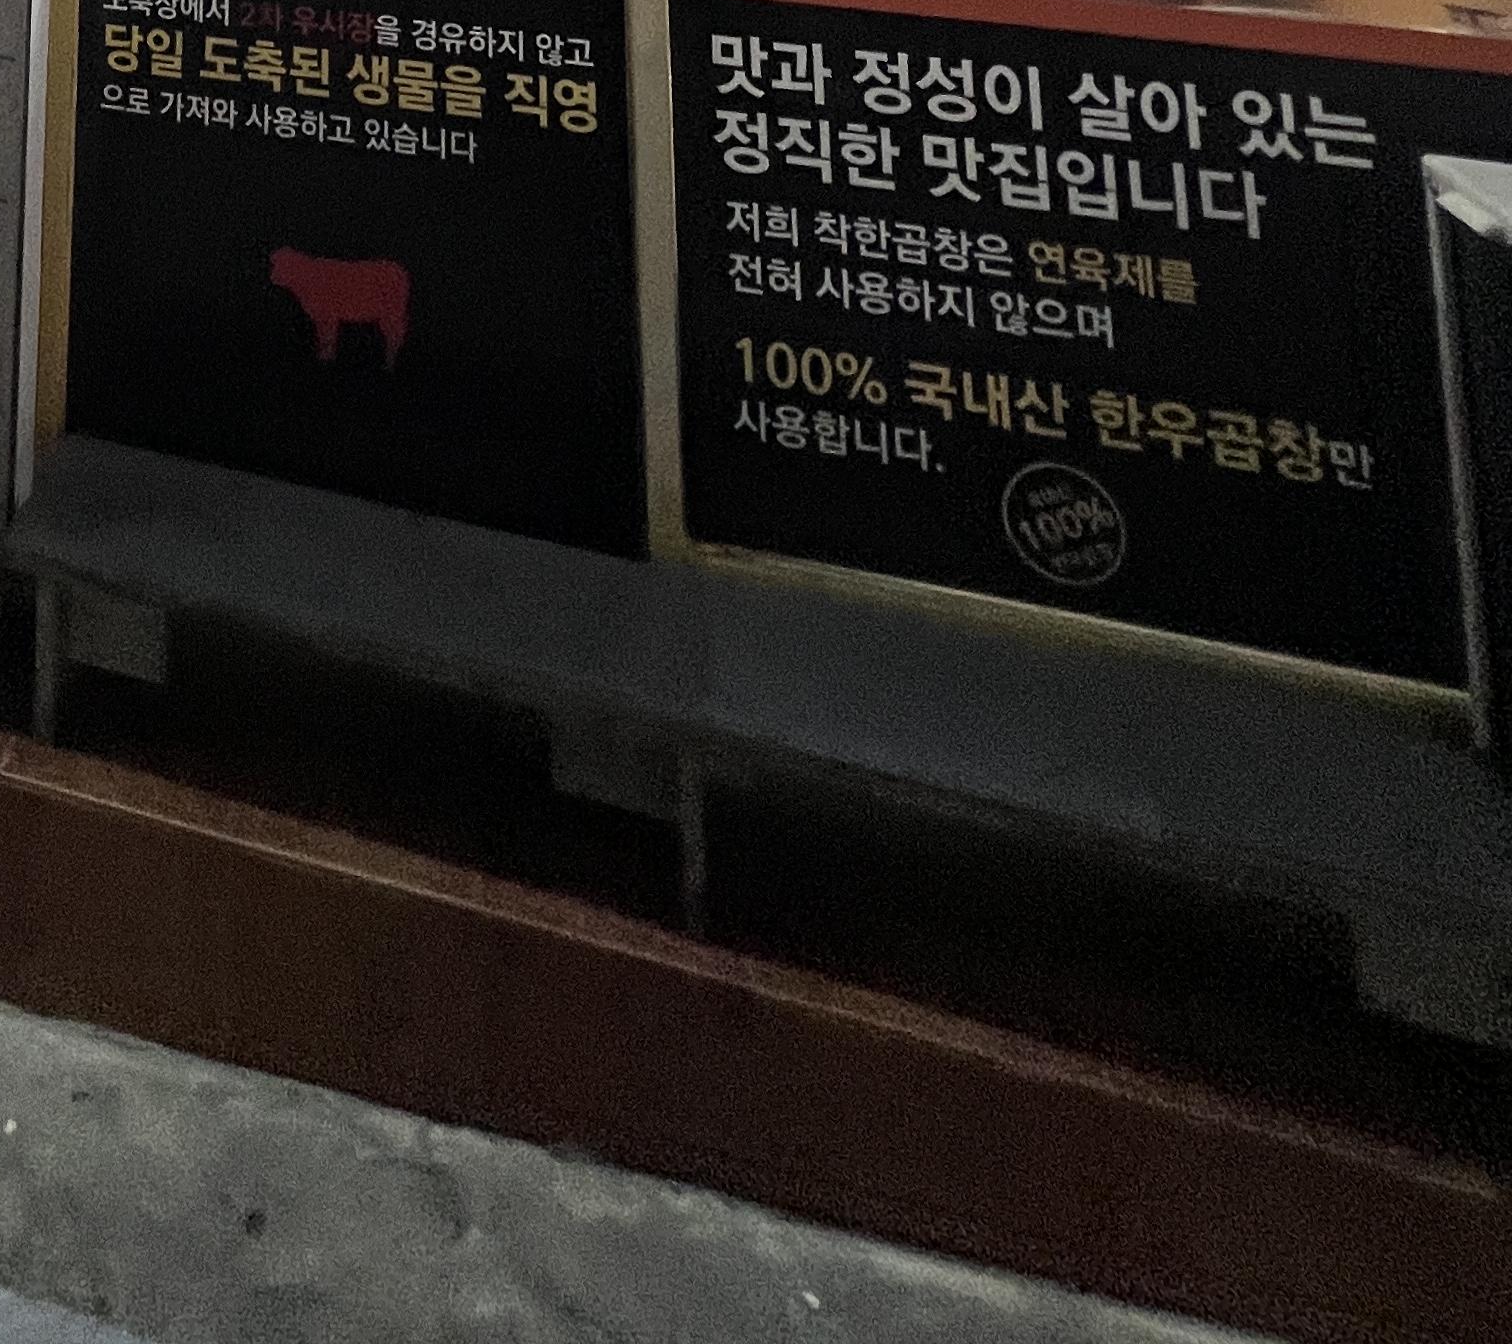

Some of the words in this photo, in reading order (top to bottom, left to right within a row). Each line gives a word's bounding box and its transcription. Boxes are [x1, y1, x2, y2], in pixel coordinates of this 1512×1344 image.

[104, 23, 184, 79] 당일
[199, 36, 332, 98] 도축된
[345, 52, 487, 119] 생물을
[503, 72, 598, 135] 직영
[412, 18, 525, 62] 경유하지
[536, 33, 595, 68] 않고
[100, 83, 150, 116] 으로
[160, 91, 239, 129] 가져와
[245, 105, 356, 146] 사용하고
[364, 118, 479, 166] 있습니다
[710, 33, 832, 105] 맛과
[851, 47, 1043, 131] 정성이
[1068, 71, 1207, 150] 살아
[1232, 89, 1377, 171] 있는
[713, 108, 901, 192] 정직한
[920, 134, 1268, 241] 맛집입니다
[726, 198, 801, 249] 저희
[812, 209, 1016, 280] 착한곱창은
[1027, 239, 1202, 308] 연육제를
[726, 252, 802, 304] 전혀
[814, 265, 977, 326] 사용하지
[990, 291, 1115, 348] 않으며
[733, 335, 889, 407] 100%
[904, 357, 1071, 443] 국내산
[1089, 387, 1376, 492] 한우곱창만
